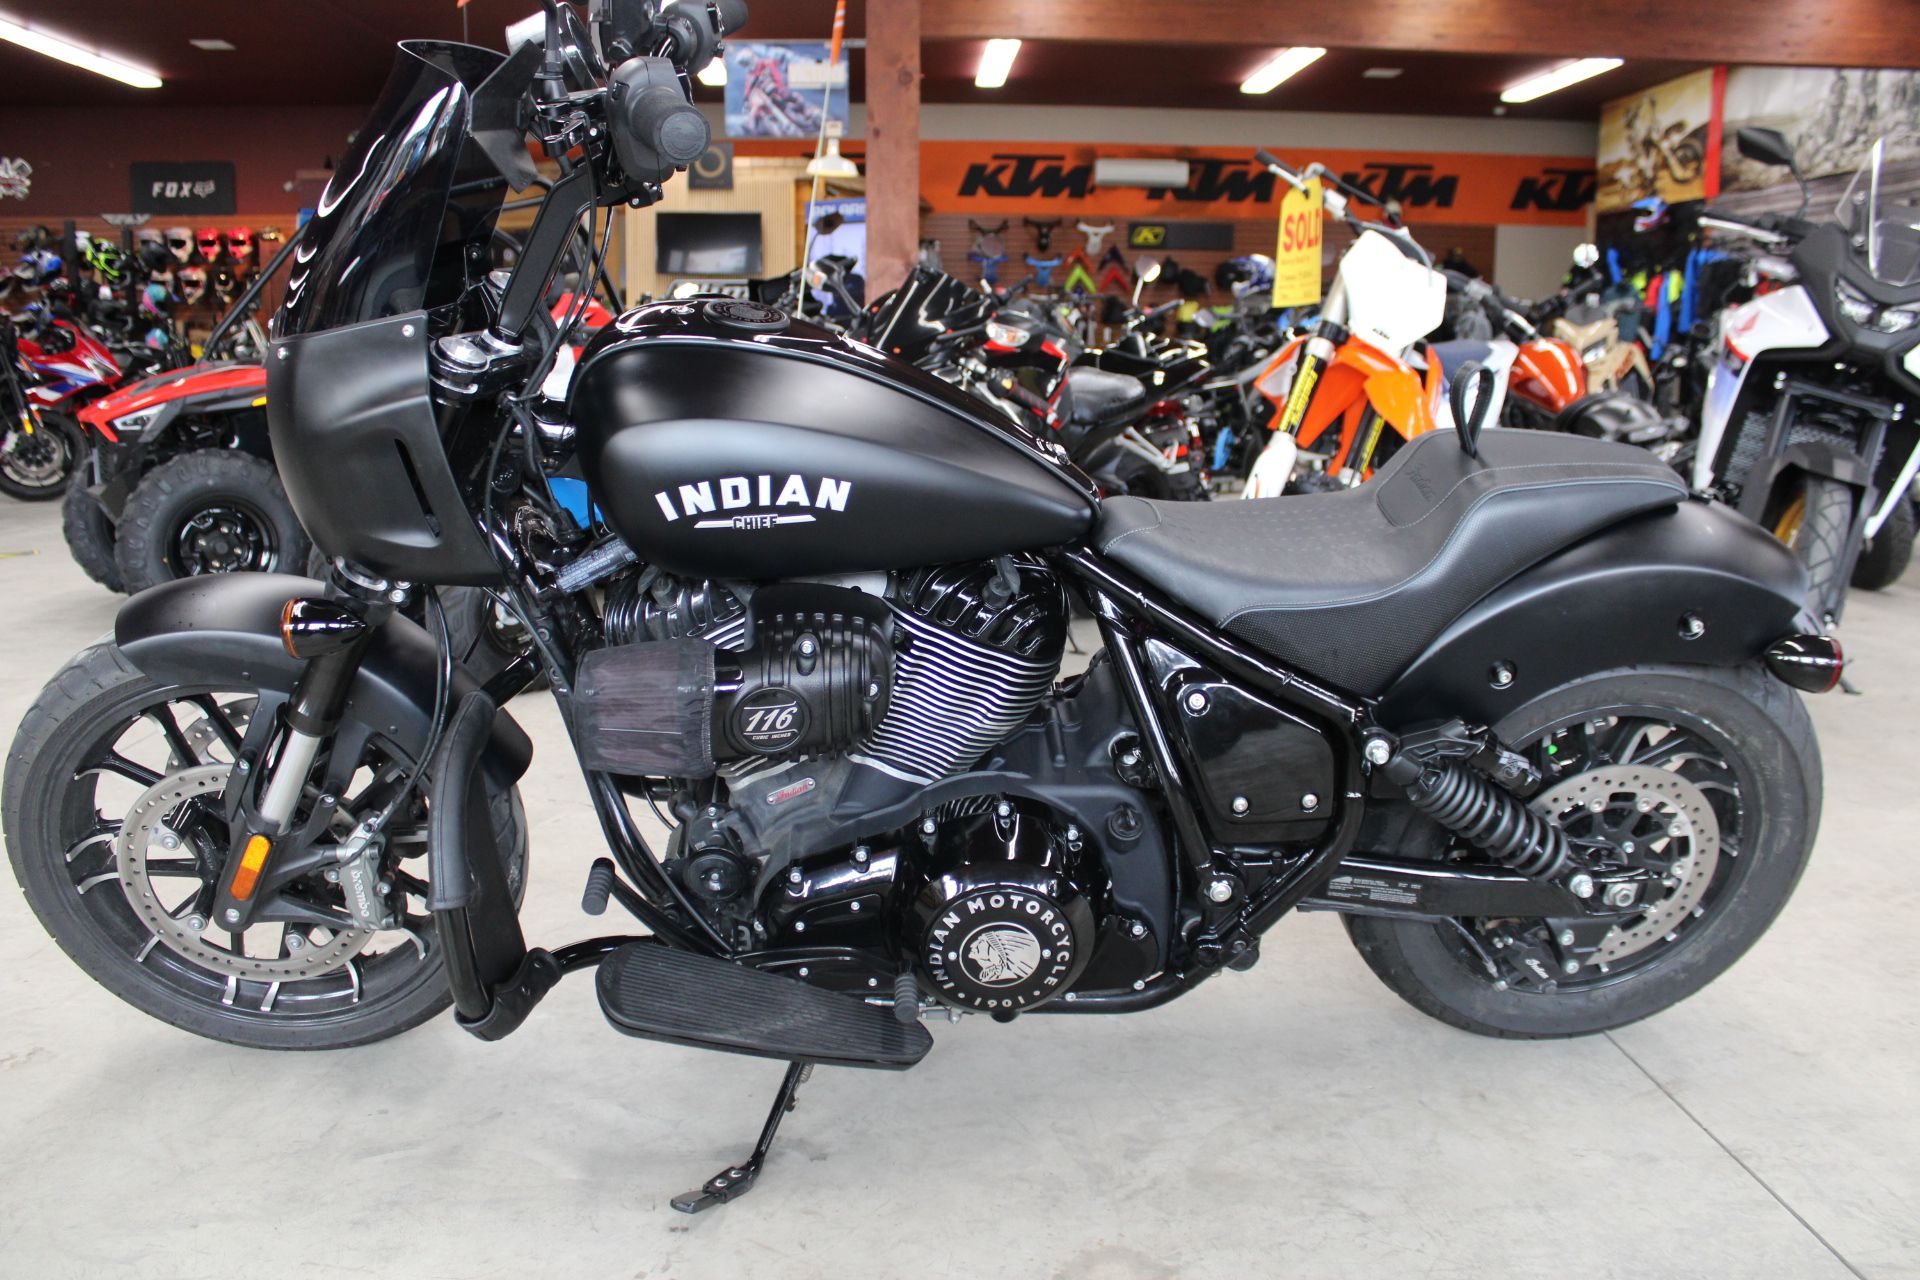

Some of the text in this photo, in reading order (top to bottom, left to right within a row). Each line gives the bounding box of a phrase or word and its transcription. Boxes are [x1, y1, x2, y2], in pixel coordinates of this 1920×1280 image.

[151, 180, 194, 199] FOX
[957, 154, 1093, 198] KTM
[1339, 162, 1460, 208] KTM
[654, 474, 852, 522] INDIAN
[731, 514, 779, 530] CHIEF
[745, 706, 798, 732] 116
[351, 869, 370, 917] brembo
[929, 894, 1071, 990] INDIAN MOTORCYCLE
[973, 995, 1026, 1009] 1901
